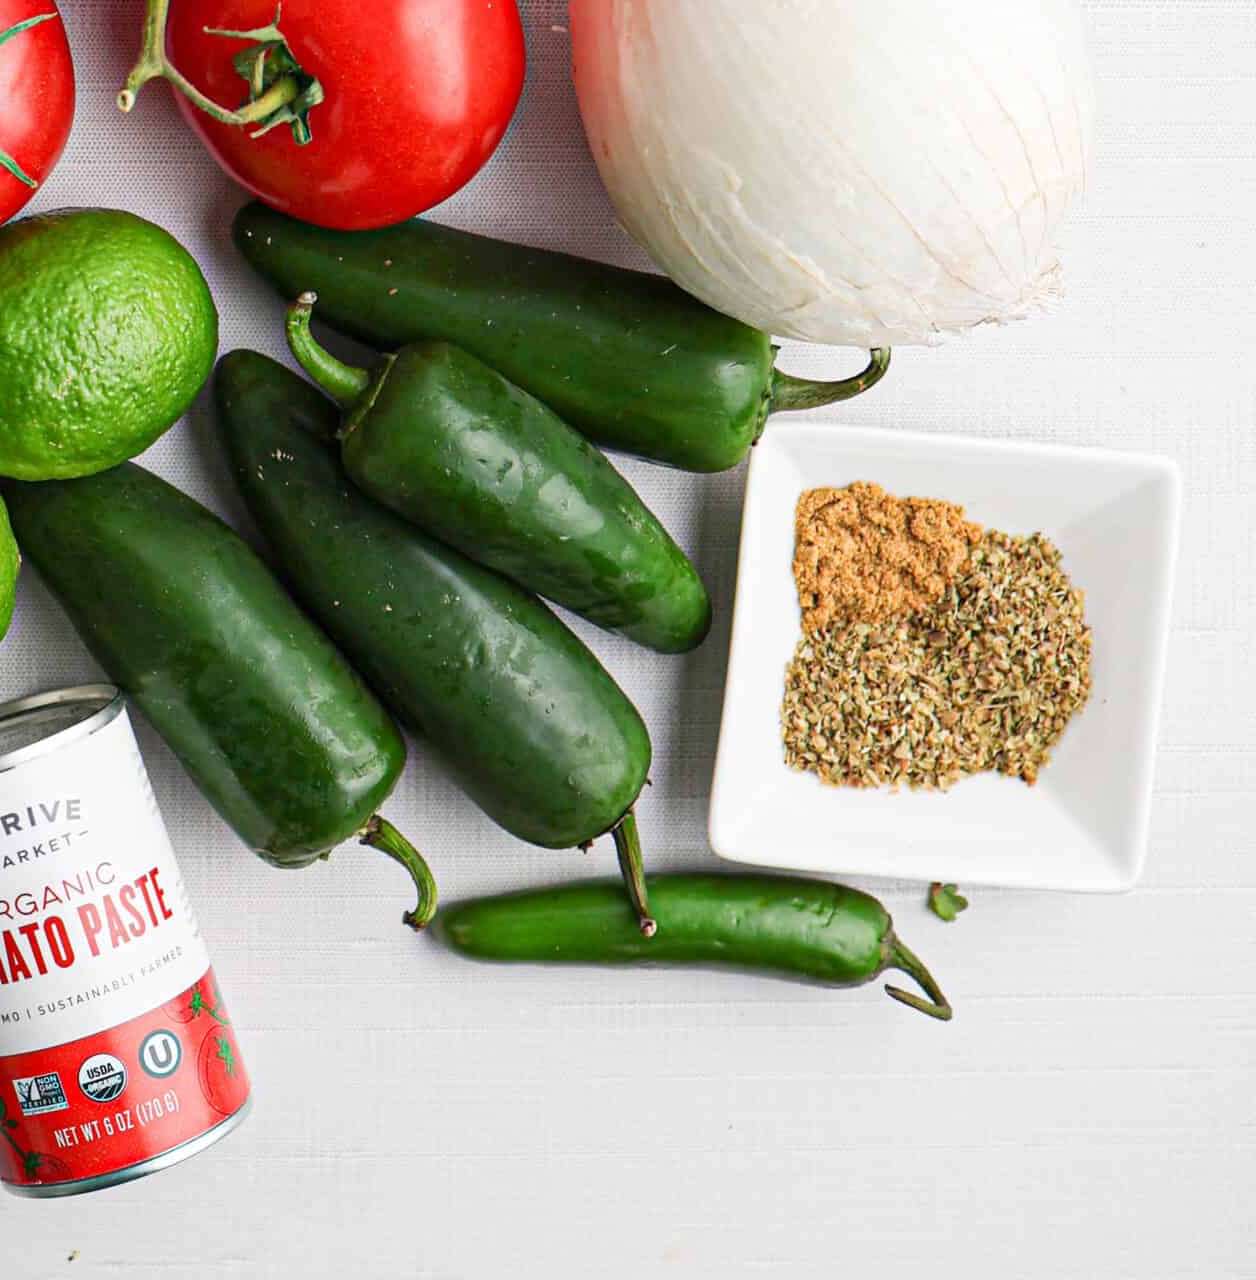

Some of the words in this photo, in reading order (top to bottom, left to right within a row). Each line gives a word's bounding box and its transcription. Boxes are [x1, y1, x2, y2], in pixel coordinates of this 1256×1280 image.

[77, 867, 173, 957] PASTE
[37, 973, 136, 1016] SUSTAINABLY
[140, 945, 183, 977] FARMED
[87, 1062, 115, 1080] USDA
[54, 1126, 79, 1149] NET
[80, 1120, 102, 1142] WT
[103, 1117, 114, 1136] 6
[115, 1110, 134, 1132] OZ
[135, 1096, 164, 1127] (170
[165, 1088, 181, 1113] G)
